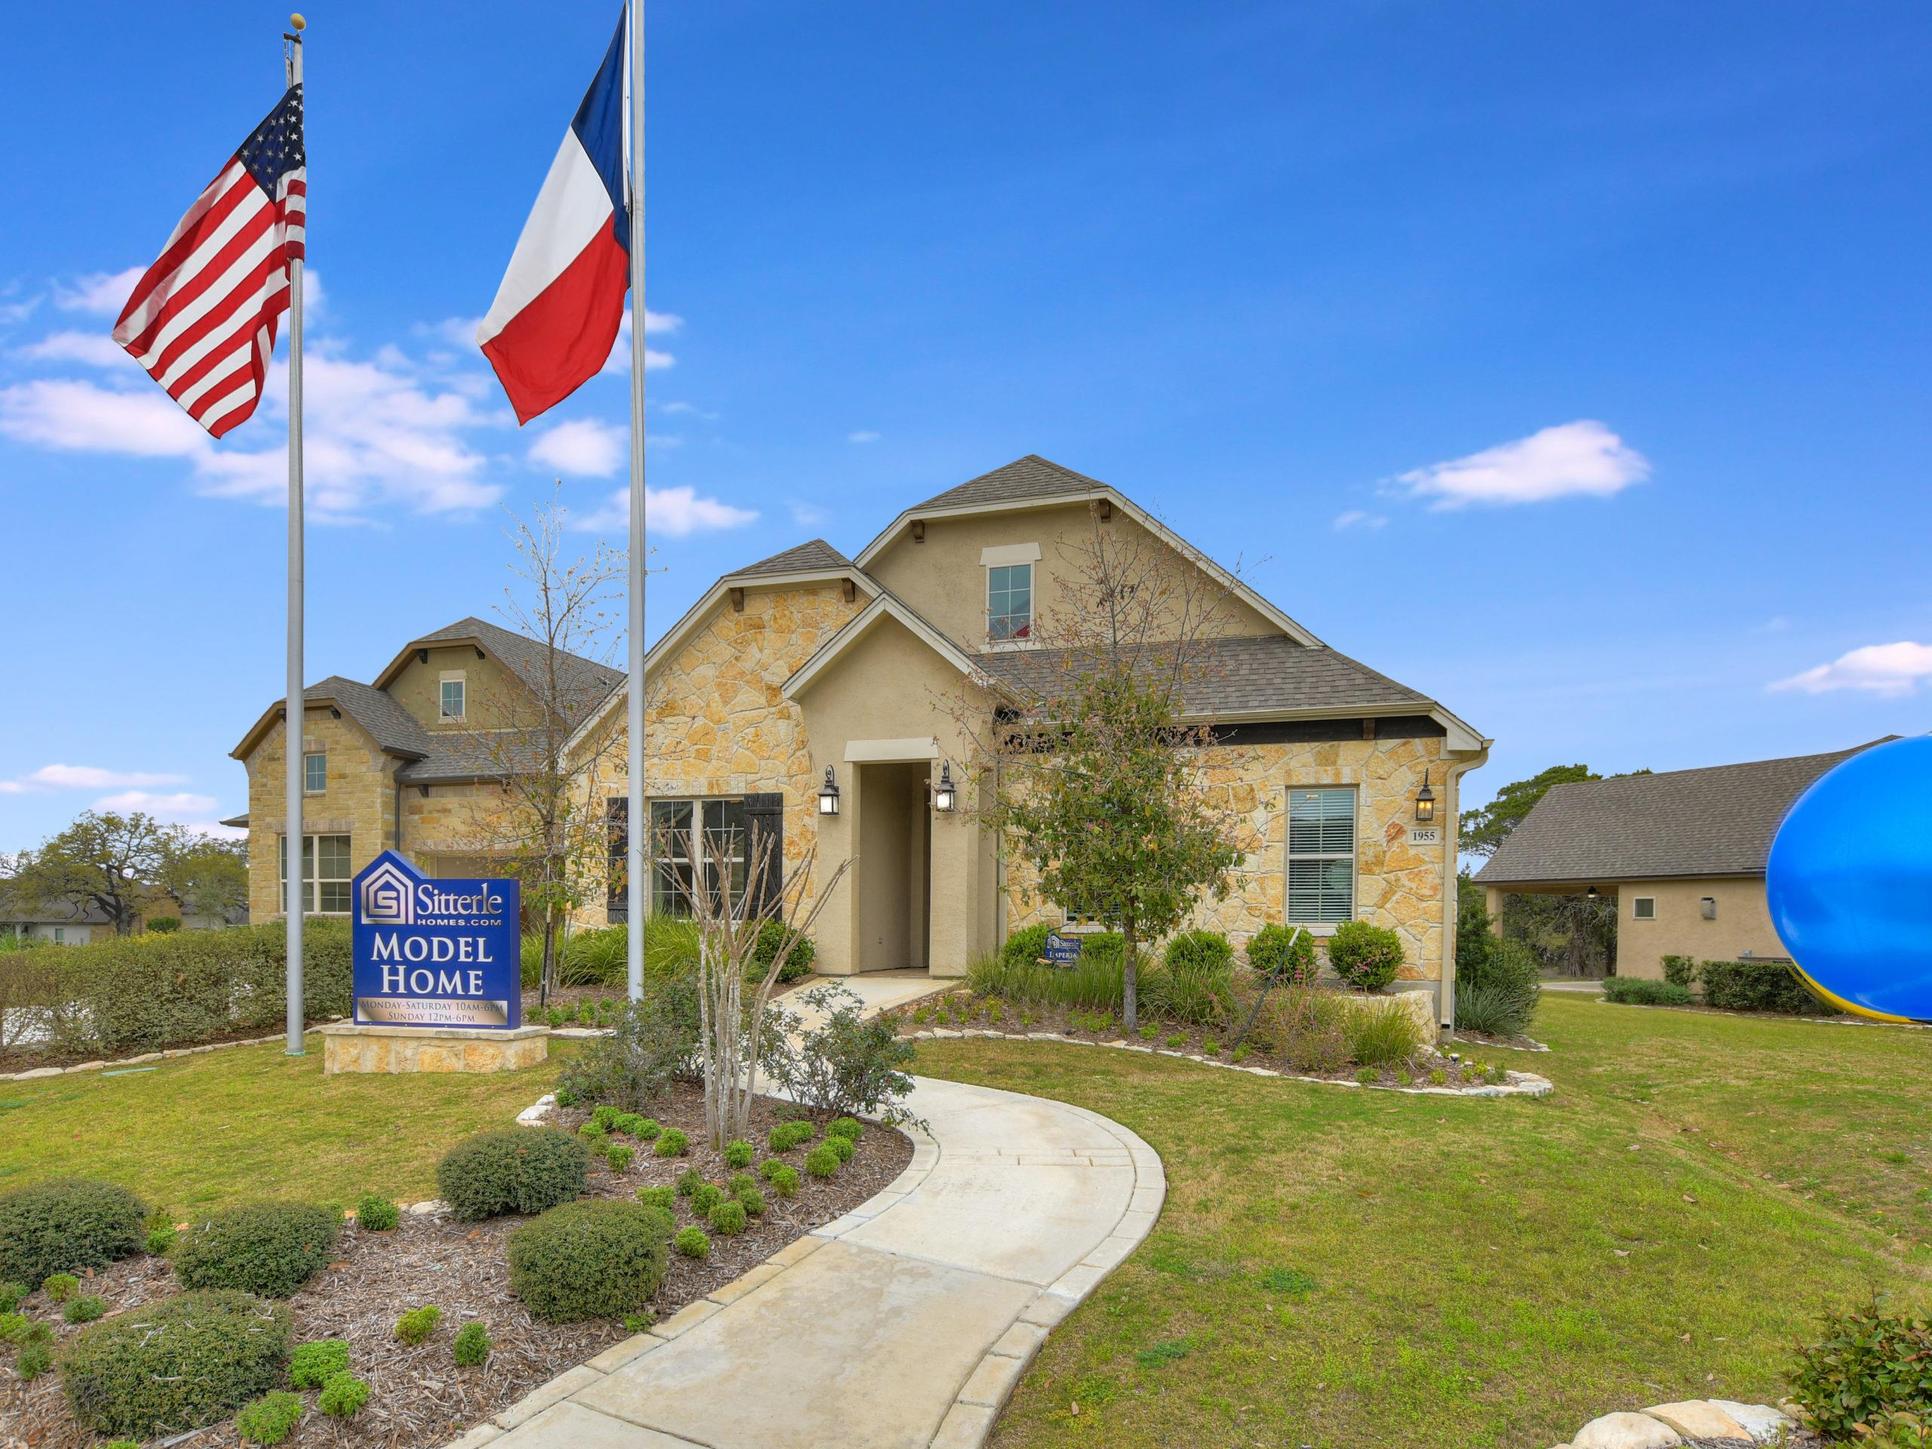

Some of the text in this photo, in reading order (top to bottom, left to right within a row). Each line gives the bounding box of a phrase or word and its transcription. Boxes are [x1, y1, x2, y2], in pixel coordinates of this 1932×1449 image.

[1413, 832, 1435, 840] 1955
[416, 882, 503, 915] Sitterle
[417, 918, 502, 926] HOMES.COM
[370, 932, 493, 963] MODEL
[380, 965, 484, 996] HOME
[387, 1012, 425, 1021] SUNDAY
